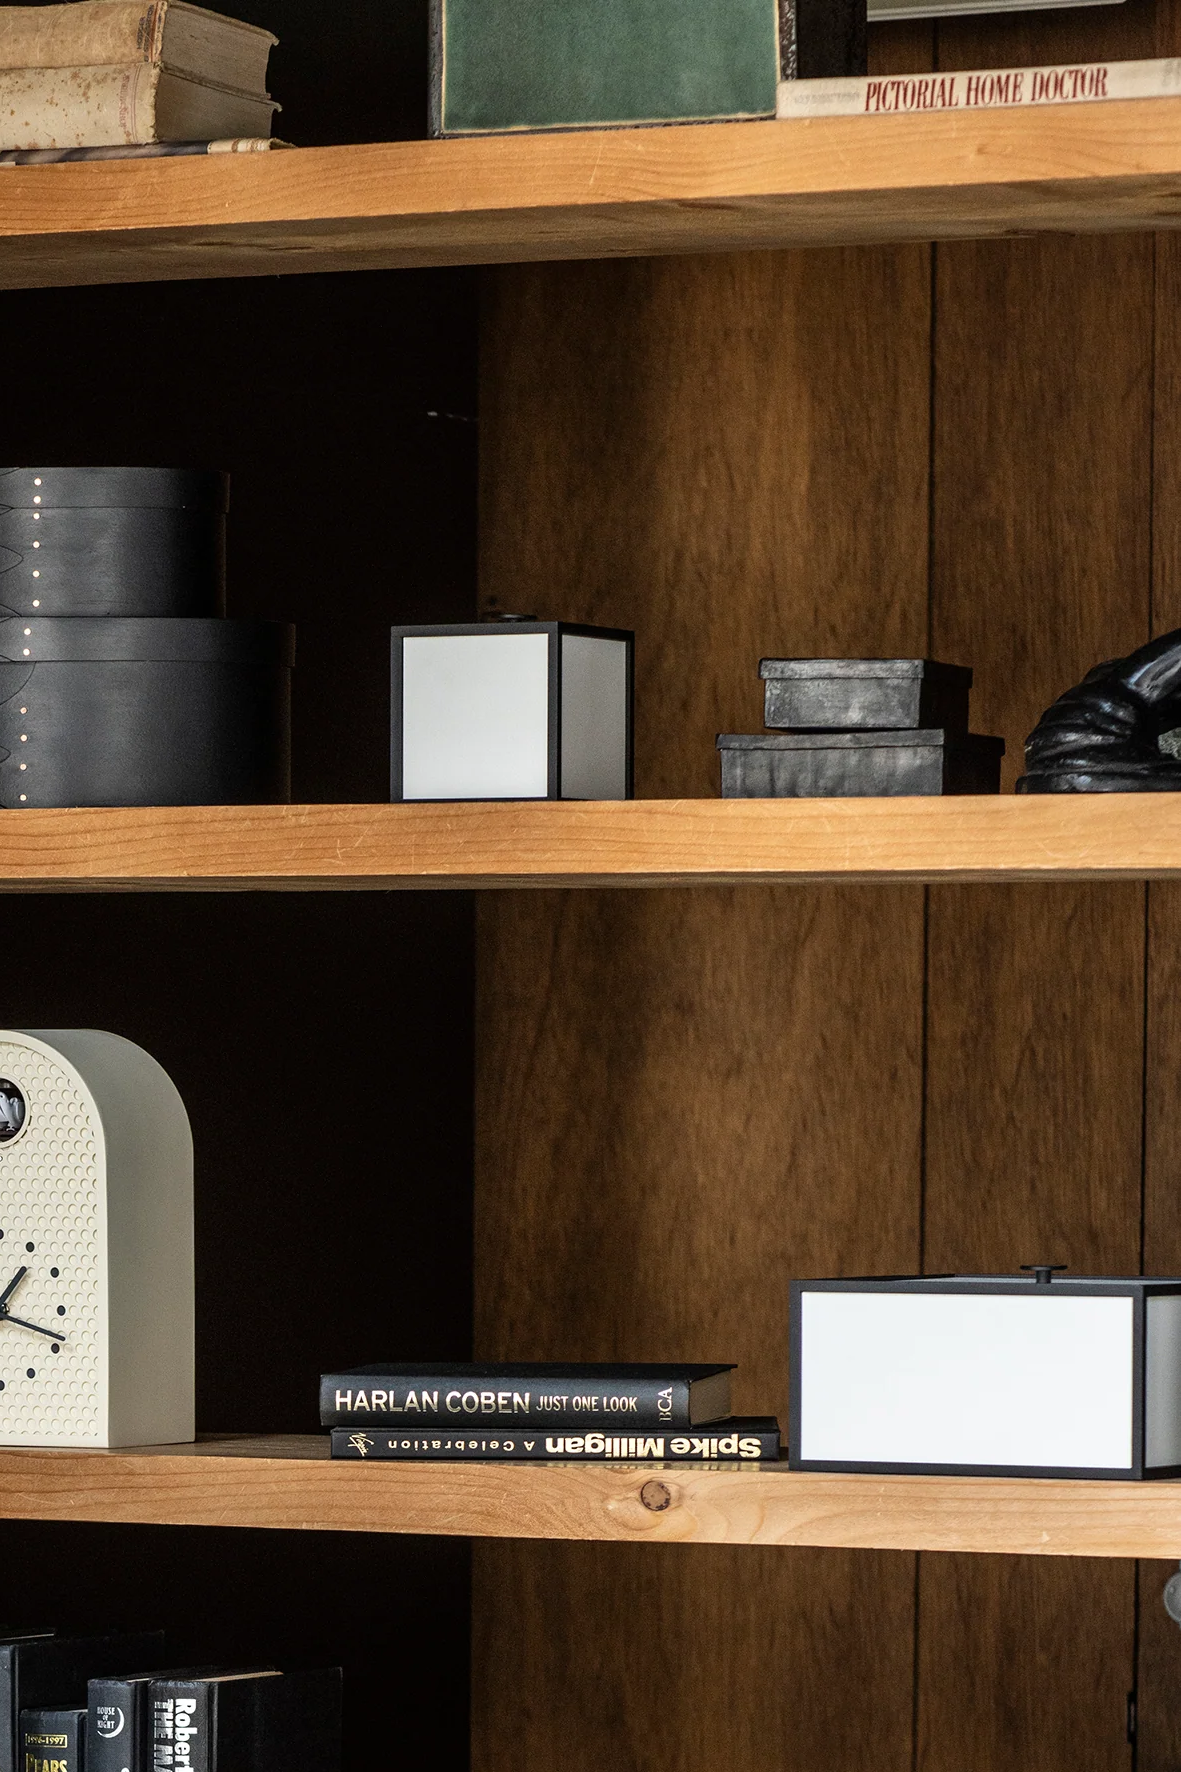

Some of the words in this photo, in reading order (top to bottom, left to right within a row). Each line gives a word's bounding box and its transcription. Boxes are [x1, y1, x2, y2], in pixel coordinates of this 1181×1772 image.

[865, 79, 959, 112] PICTORIAL
[966, 72, 1023, 106] HOME
[1031, 66, 1108, 101] DOCTOR
[335, 1389, 439, 1413] HARLAN
[445, 1391, 530, 1414] COBEN
[536, 1395, 568, 1412] JUST
[572, 1396, 599, 1412] ONE
[603, 1396, 637, 1413] LOOK
[658, 1386, 672, 1422] BCA
[388, 1439, 514, 1452] Celebration
[523, 1441, 534, 1451] A
[545, 1433, 665, 1458] Milligan
[670, 1437, 761, 1459] Spike
[97, 1706, 115, 1716] HOUSE
[154, 1698, 173, 1739] THE
